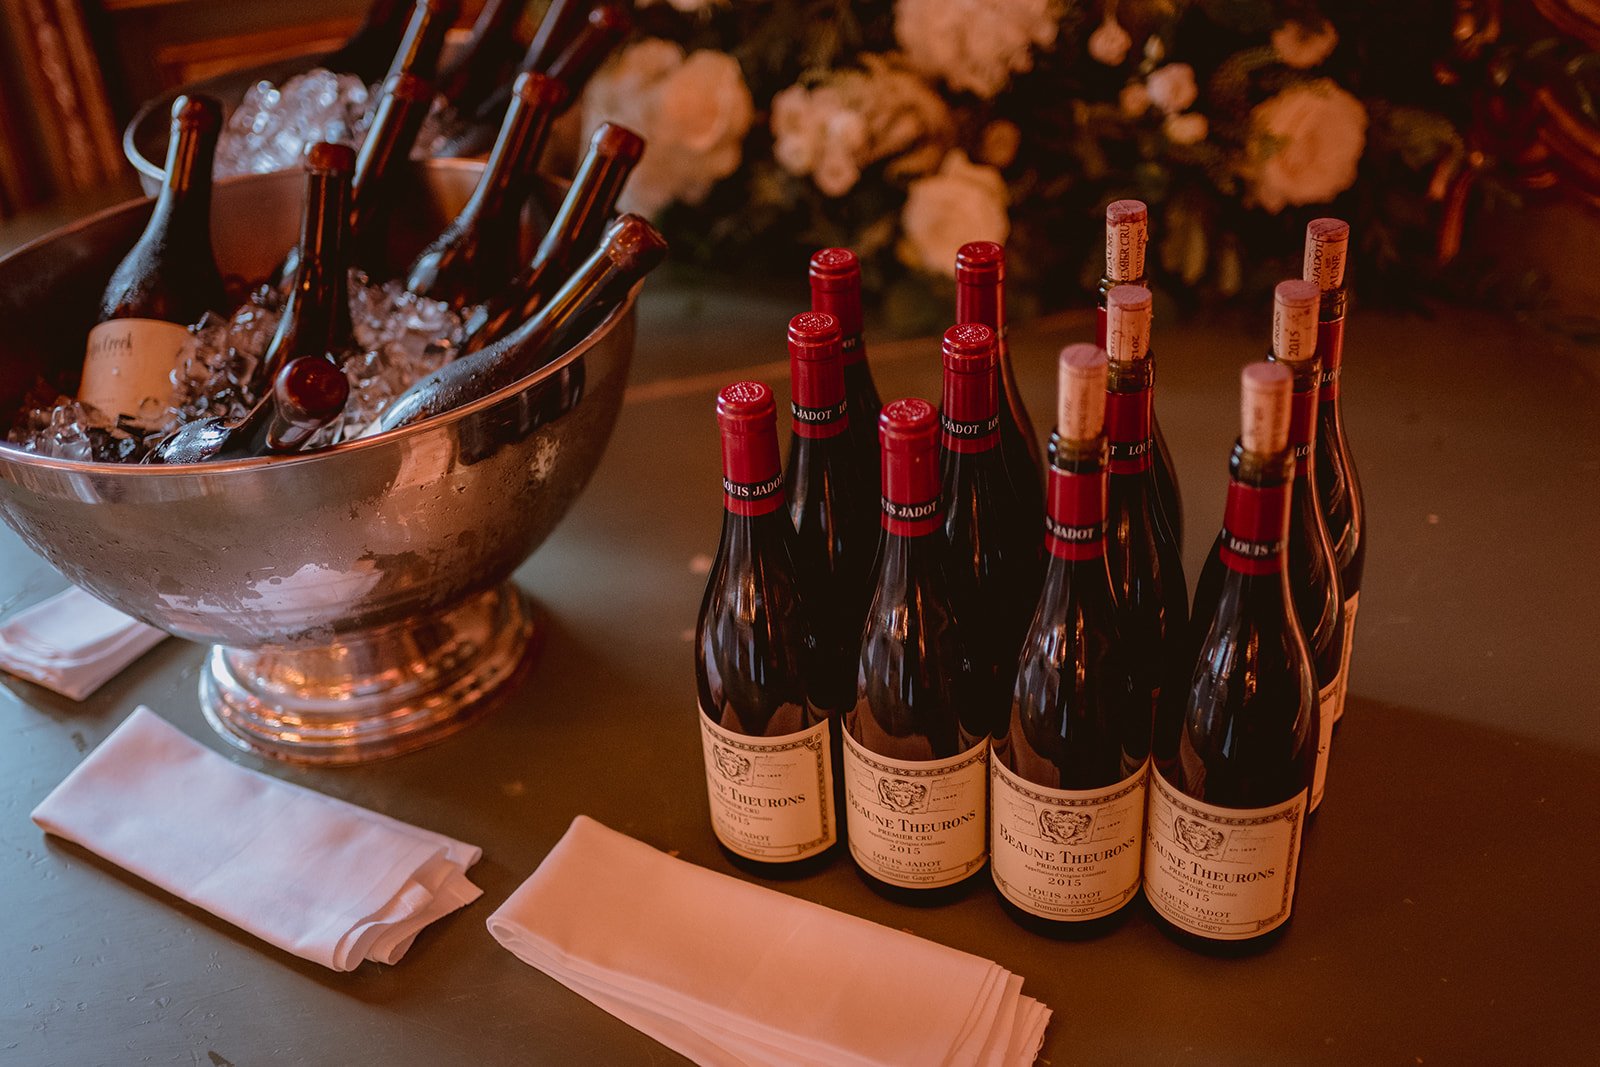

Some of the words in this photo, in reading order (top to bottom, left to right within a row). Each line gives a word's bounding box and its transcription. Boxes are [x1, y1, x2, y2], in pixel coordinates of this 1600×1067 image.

[1287, 330, 1301, 357] 2015
[796, 408, 832, 420] JADOT
[944, 422, 979, 435] JADOT
[898, 501, 937, 518] JADOT
[1053, 524, 1095, 541] JADOT
[1229, 536, 1268, 556] LOUIS
[728, 785, 806, 809] THEURONS
[898, 809, 976, 834] THEURONS
[877, 827, 913, 841] PREMIER
[889, 844, 921, 856] 2015
[1000, 822, 1055, 862] BEAUNE
[1059, 835, 1136, 864] THEURONS
[872, 850, 903, 867] LOUIS
[905, 859, 942, 868] JADOT
[1036, 861, 1075, 873] PREMIER
[1077, 865, 1096, 873] CRU
[1168, 865, 1204, 886] PREMIER
[1206, 882, 1225, 891] CRU
[1190, 861, 1275, 884] THEURONS
[1048, 877, 1082, 887] 2015
[1028, 885, 1062, 899] LOUIS
[1064, 890, 1103, 900] JADOT
[1178, 885, 1210, 902] 2015
[1034, 902, 1069, 913] Domaine
[1160, 887, 1189, 909] LOUIS
[1192, 906, 1231, 919] JADOT
[1197, 921, 1223, 932] Gagey
